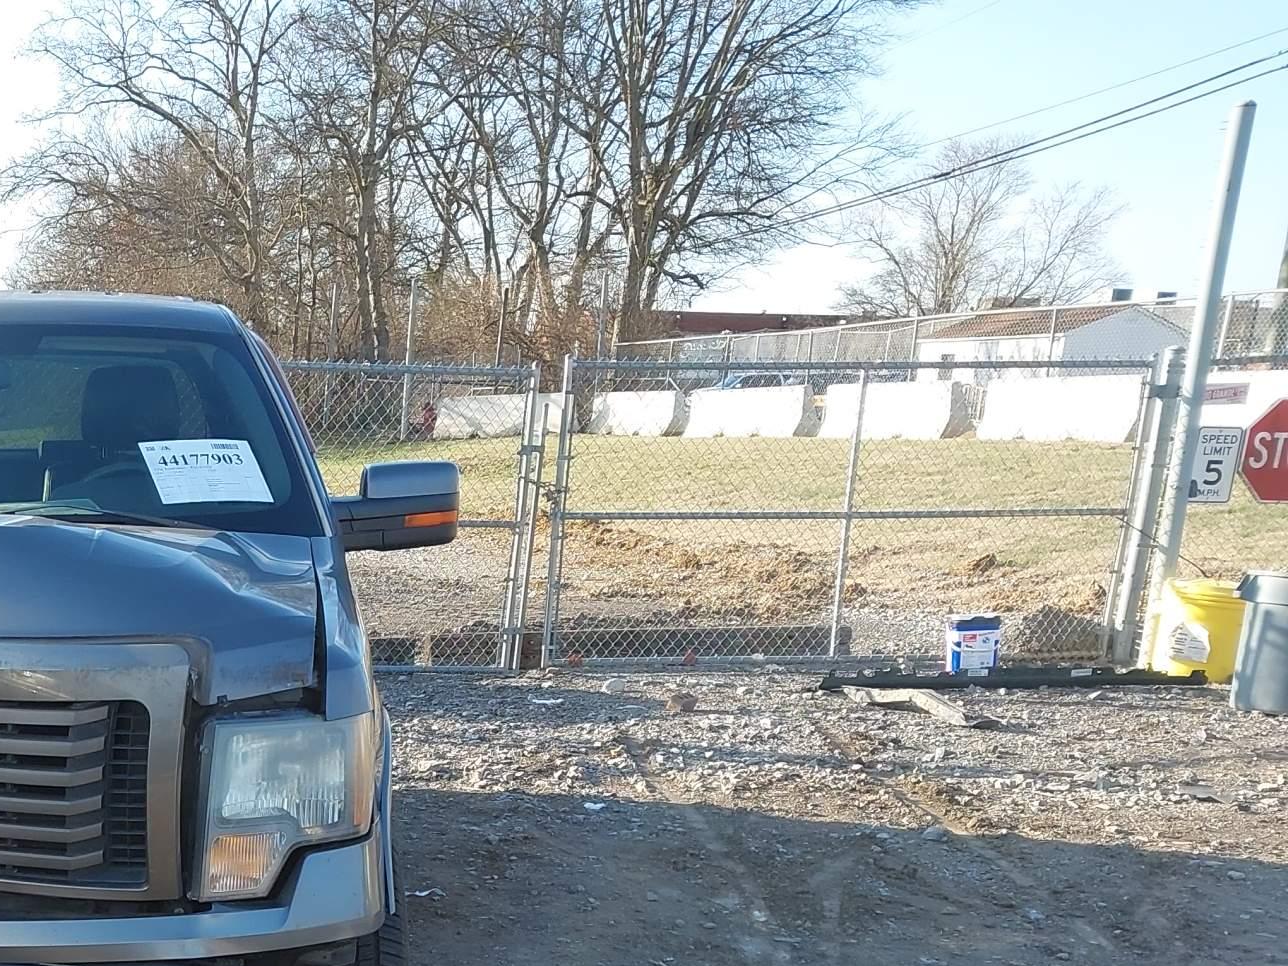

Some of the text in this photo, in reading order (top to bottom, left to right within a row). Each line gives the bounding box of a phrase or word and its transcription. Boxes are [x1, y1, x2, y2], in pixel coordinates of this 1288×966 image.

[1201, 434, 1239, 445] SPEED
[1202, 446, 1233, 456] LIMIT
[1248, 431, 1288, 469] ST
[158, 453, 244, 466] 44177903
[1202, 459, 1224, 486] 5
